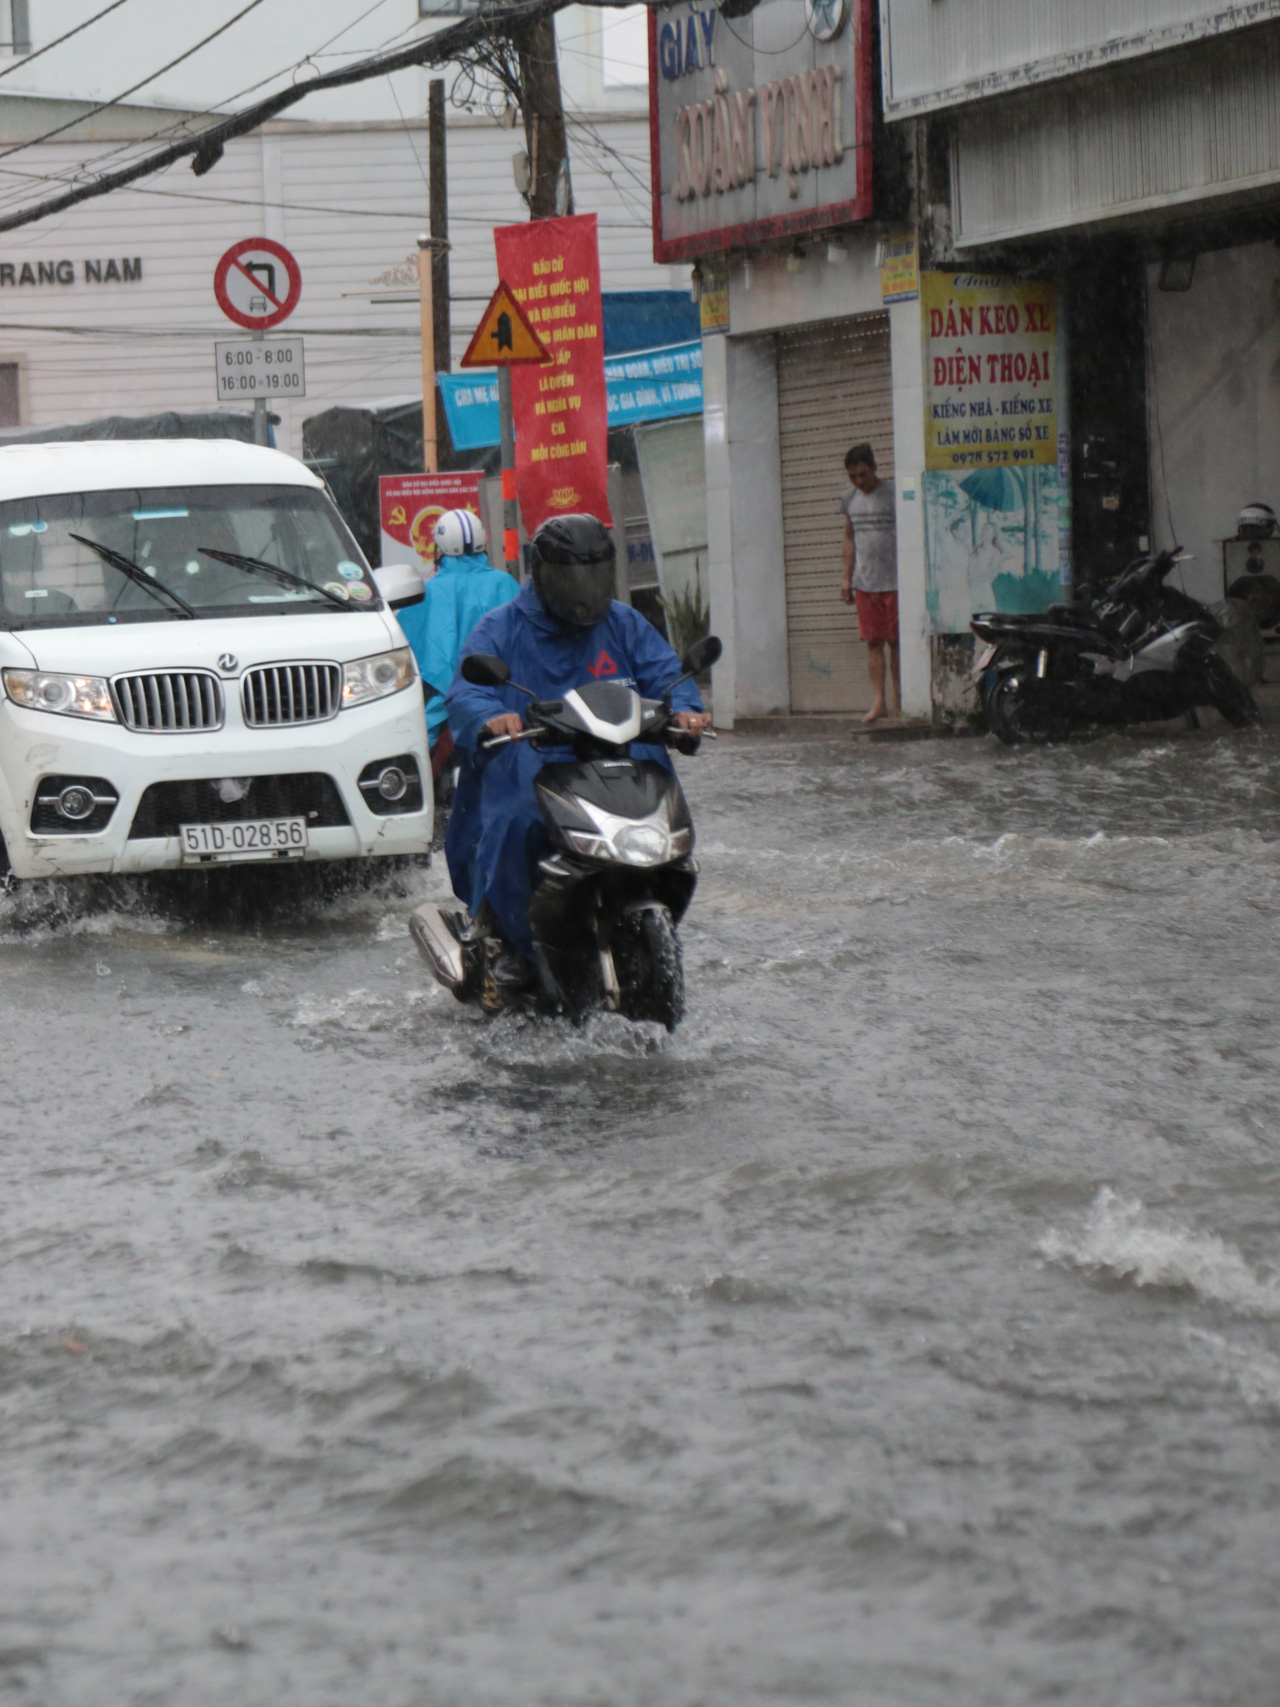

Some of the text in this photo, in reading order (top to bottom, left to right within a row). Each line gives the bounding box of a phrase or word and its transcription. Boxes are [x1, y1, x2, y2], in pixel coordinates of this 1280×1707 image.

[84, 256, 143, 283] NAM
[930, 298, 1051, 338] DÁN KEO XE
[225, 351, 253, 366] 6:00
[264, 349, 293, 364] 8:00
[933, 346, 1050, 393] ĐIỆN THOẠI
[222, 373, 300, 391] 16:00 19:00
[933, 396, 967, 419] KIẾNG
[969, 397, 993, 417] NHÀ
[1001, 393, 1036, 416] KIẾNG
[1038, 398, 1053, 414] XE
[937, 419, 1050, 446] LÀM MỚI BẢNG SỐ XE
[951, 448, 1036, 465] 0978 572 901
[186, 821, 304, 850] 51D-028.56
